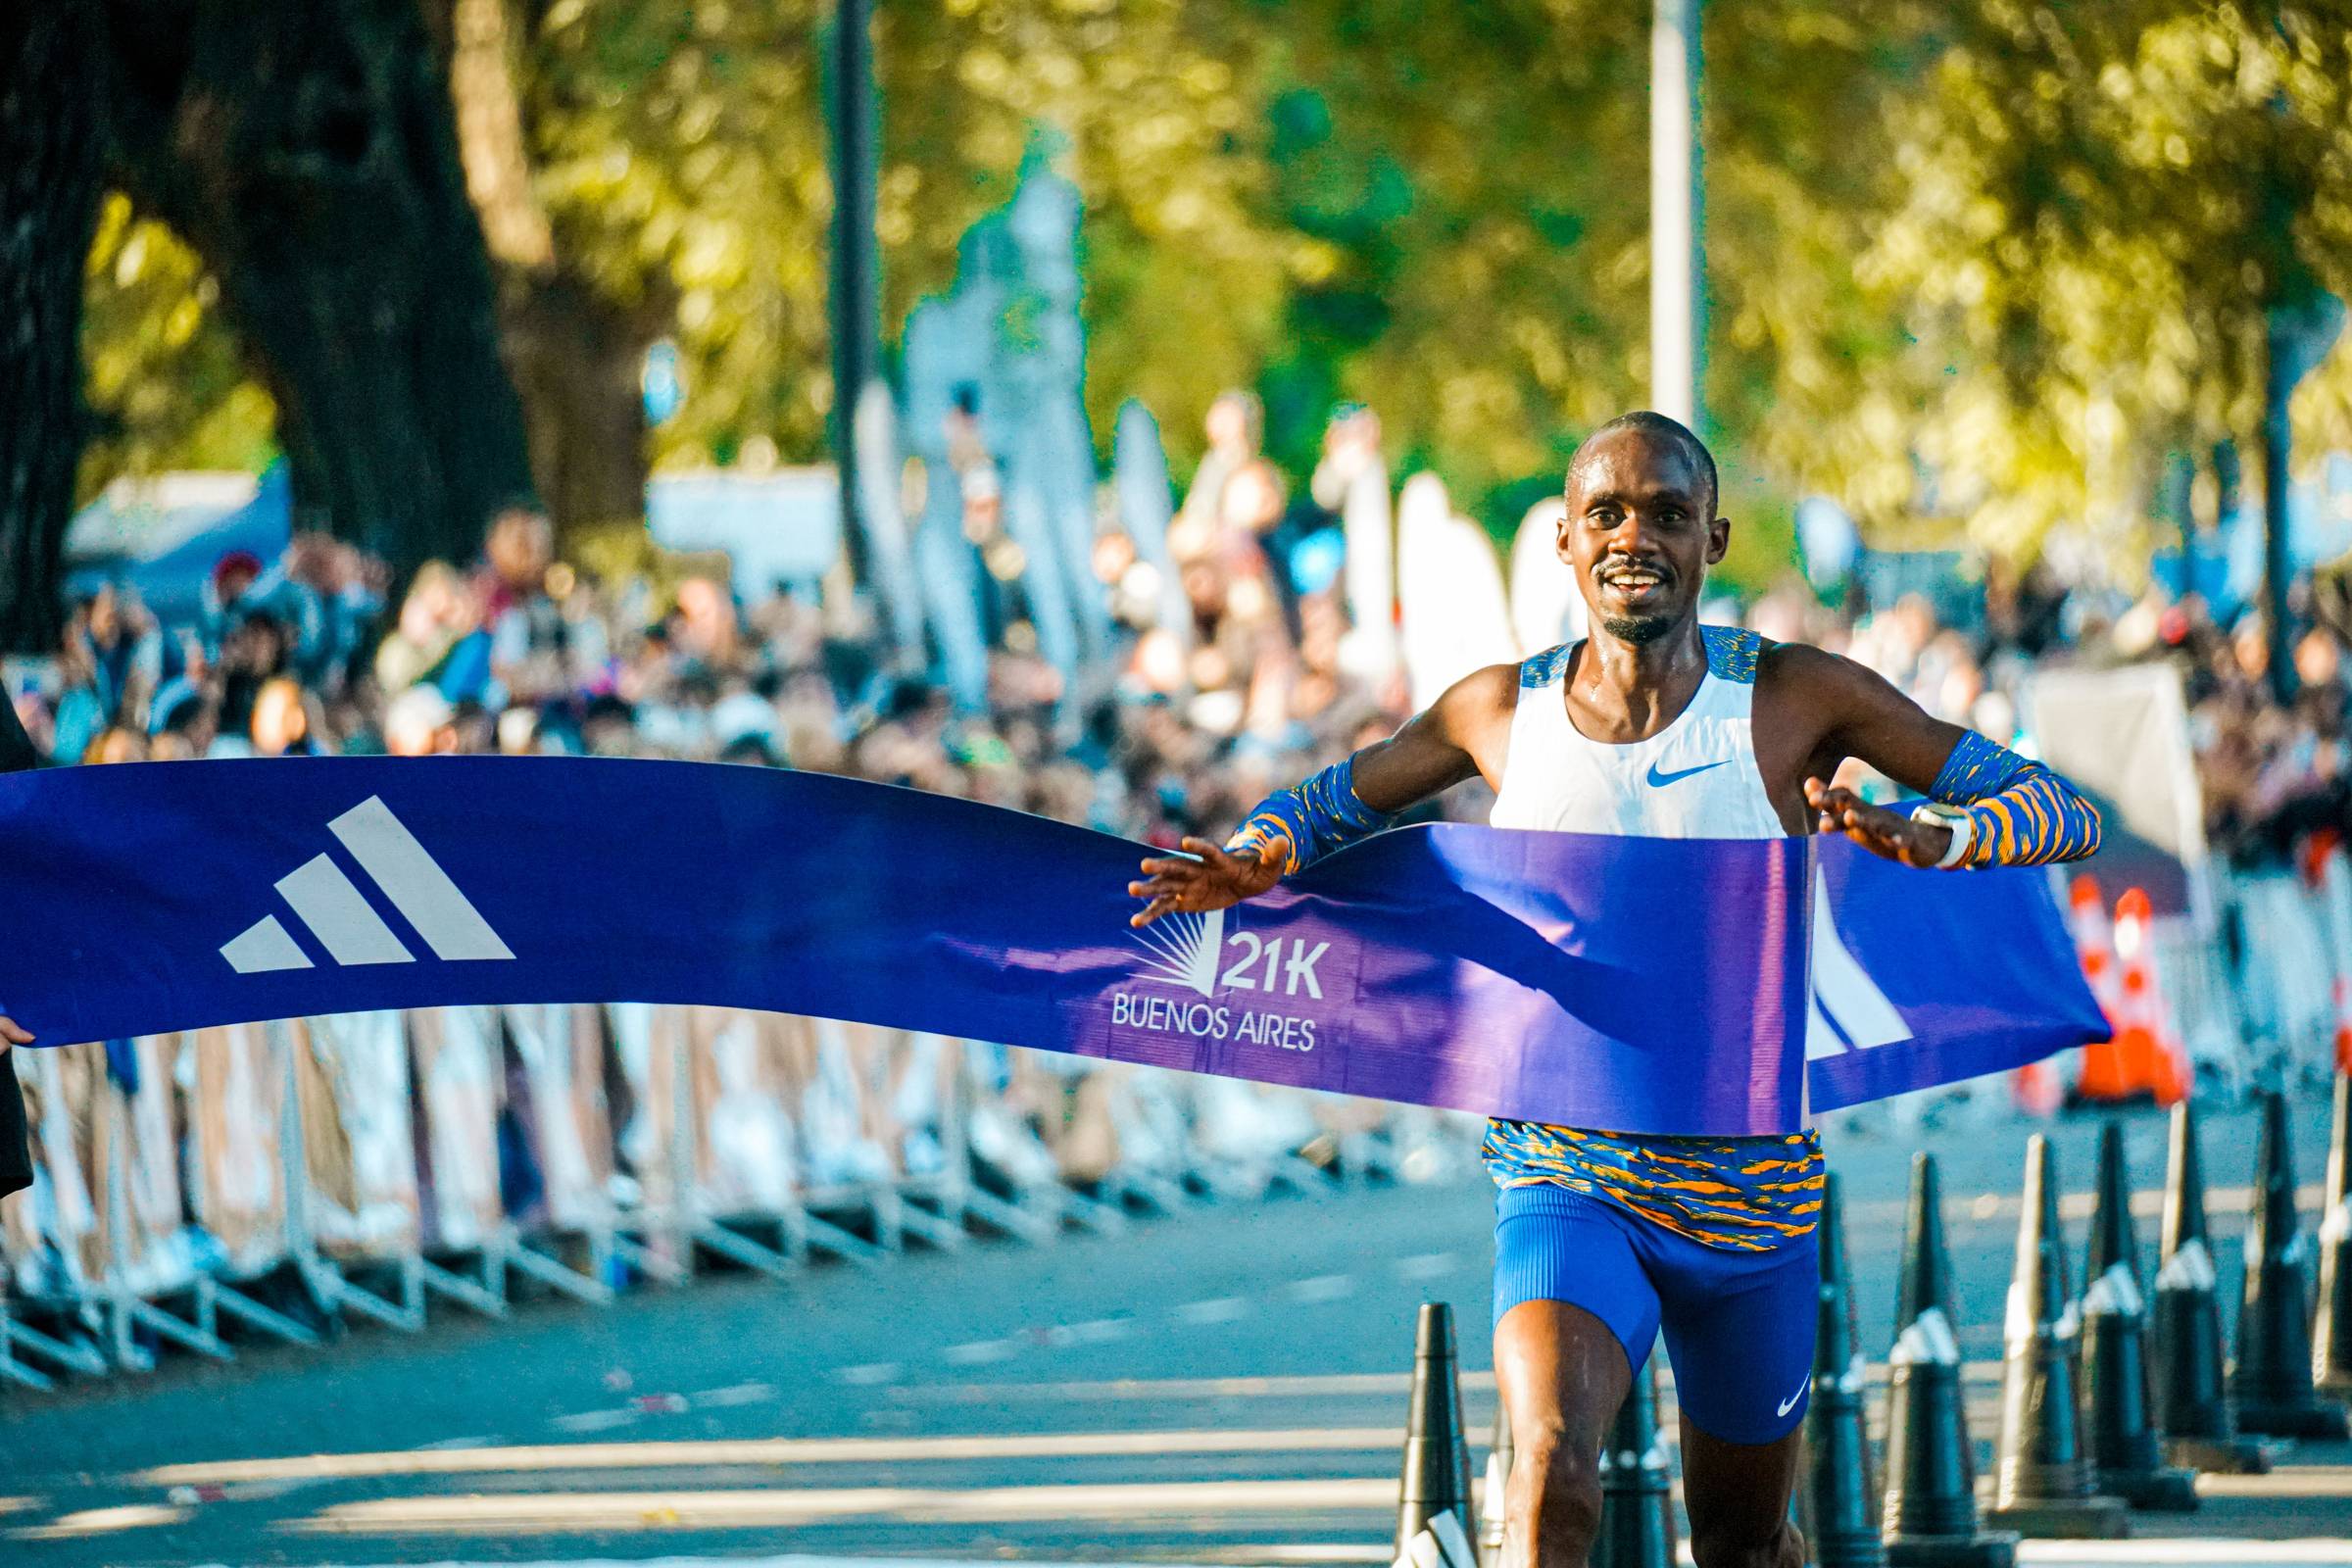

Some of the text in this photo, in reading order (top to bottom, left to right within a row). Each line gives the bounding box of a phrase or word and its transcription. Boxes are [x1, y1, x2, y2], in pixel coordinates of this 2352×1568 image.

[1221, 931, 1331, 1000] 21K
[1111, 993, 1316, 1052] BUENOS AIRES
